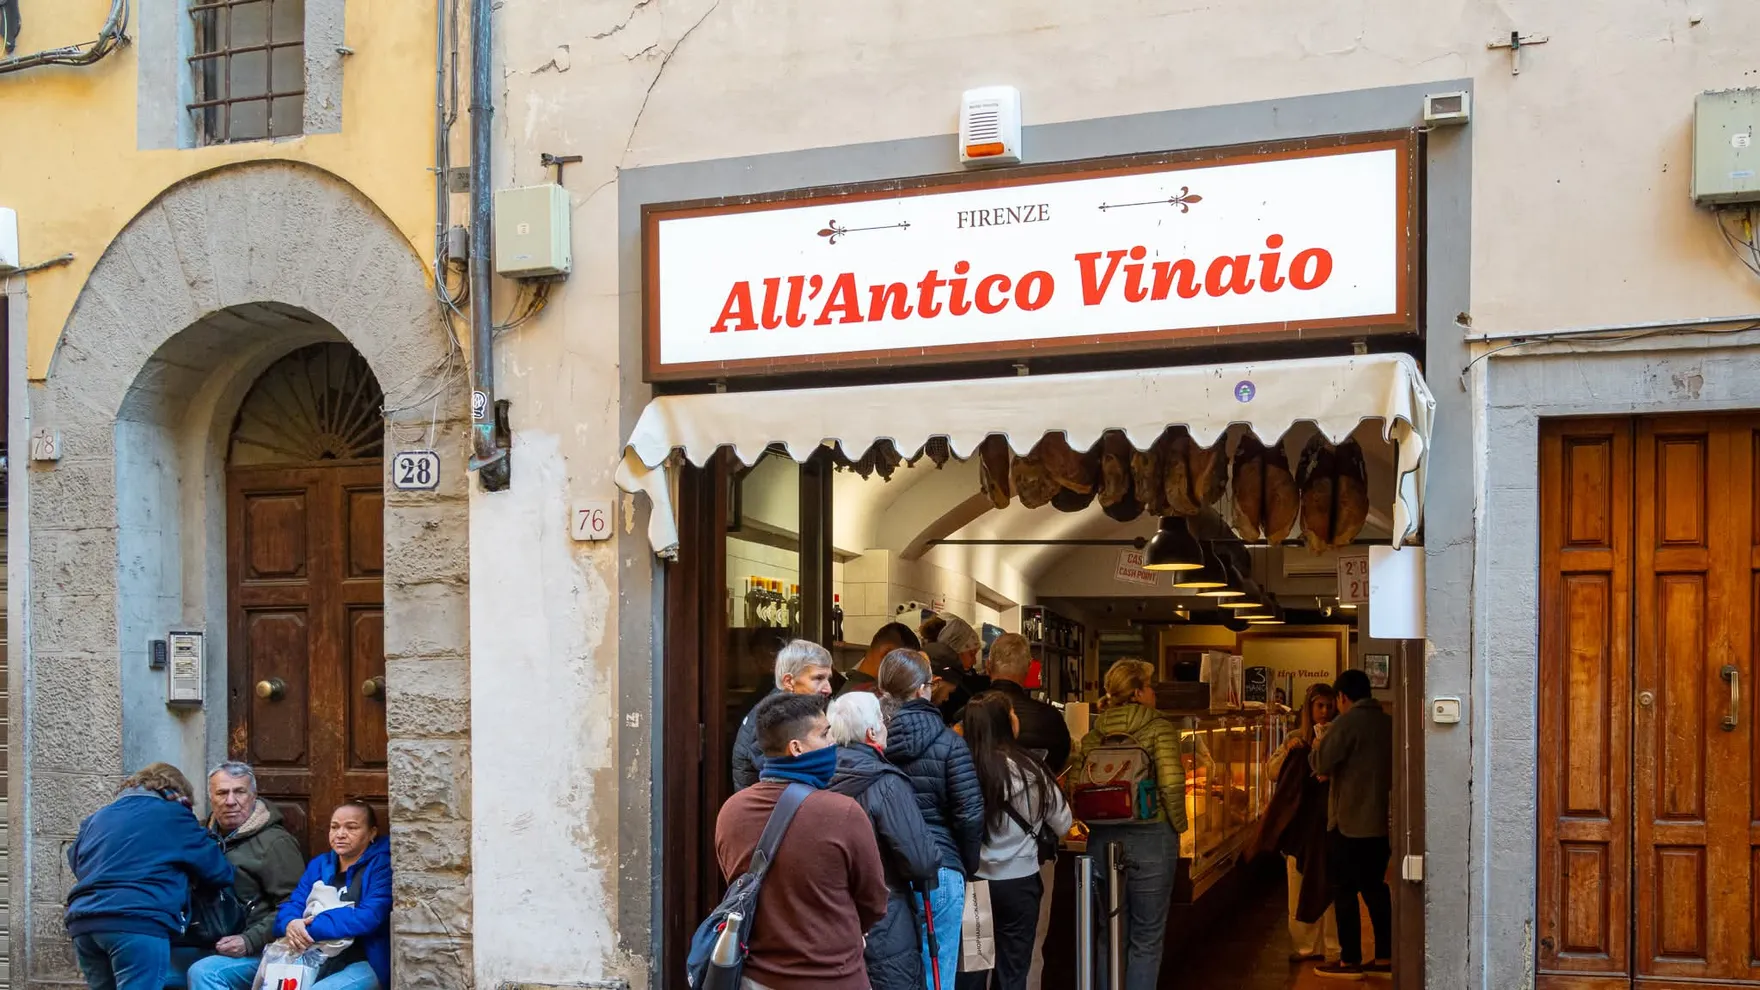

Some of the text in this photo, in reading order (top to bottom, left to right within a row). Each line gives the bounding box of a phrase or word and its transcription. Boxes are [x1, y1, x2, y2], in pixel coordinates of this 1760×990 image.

[957, 203, 1050, 229] FIRENZE
[1074, 233, 1333, 307] Vinaio
[34, 435, 54, 455] 78
[400, 458, 431, 484] 28
[579, 509, 604, 531] 76
[1251, 668, 1266, 684] 3
